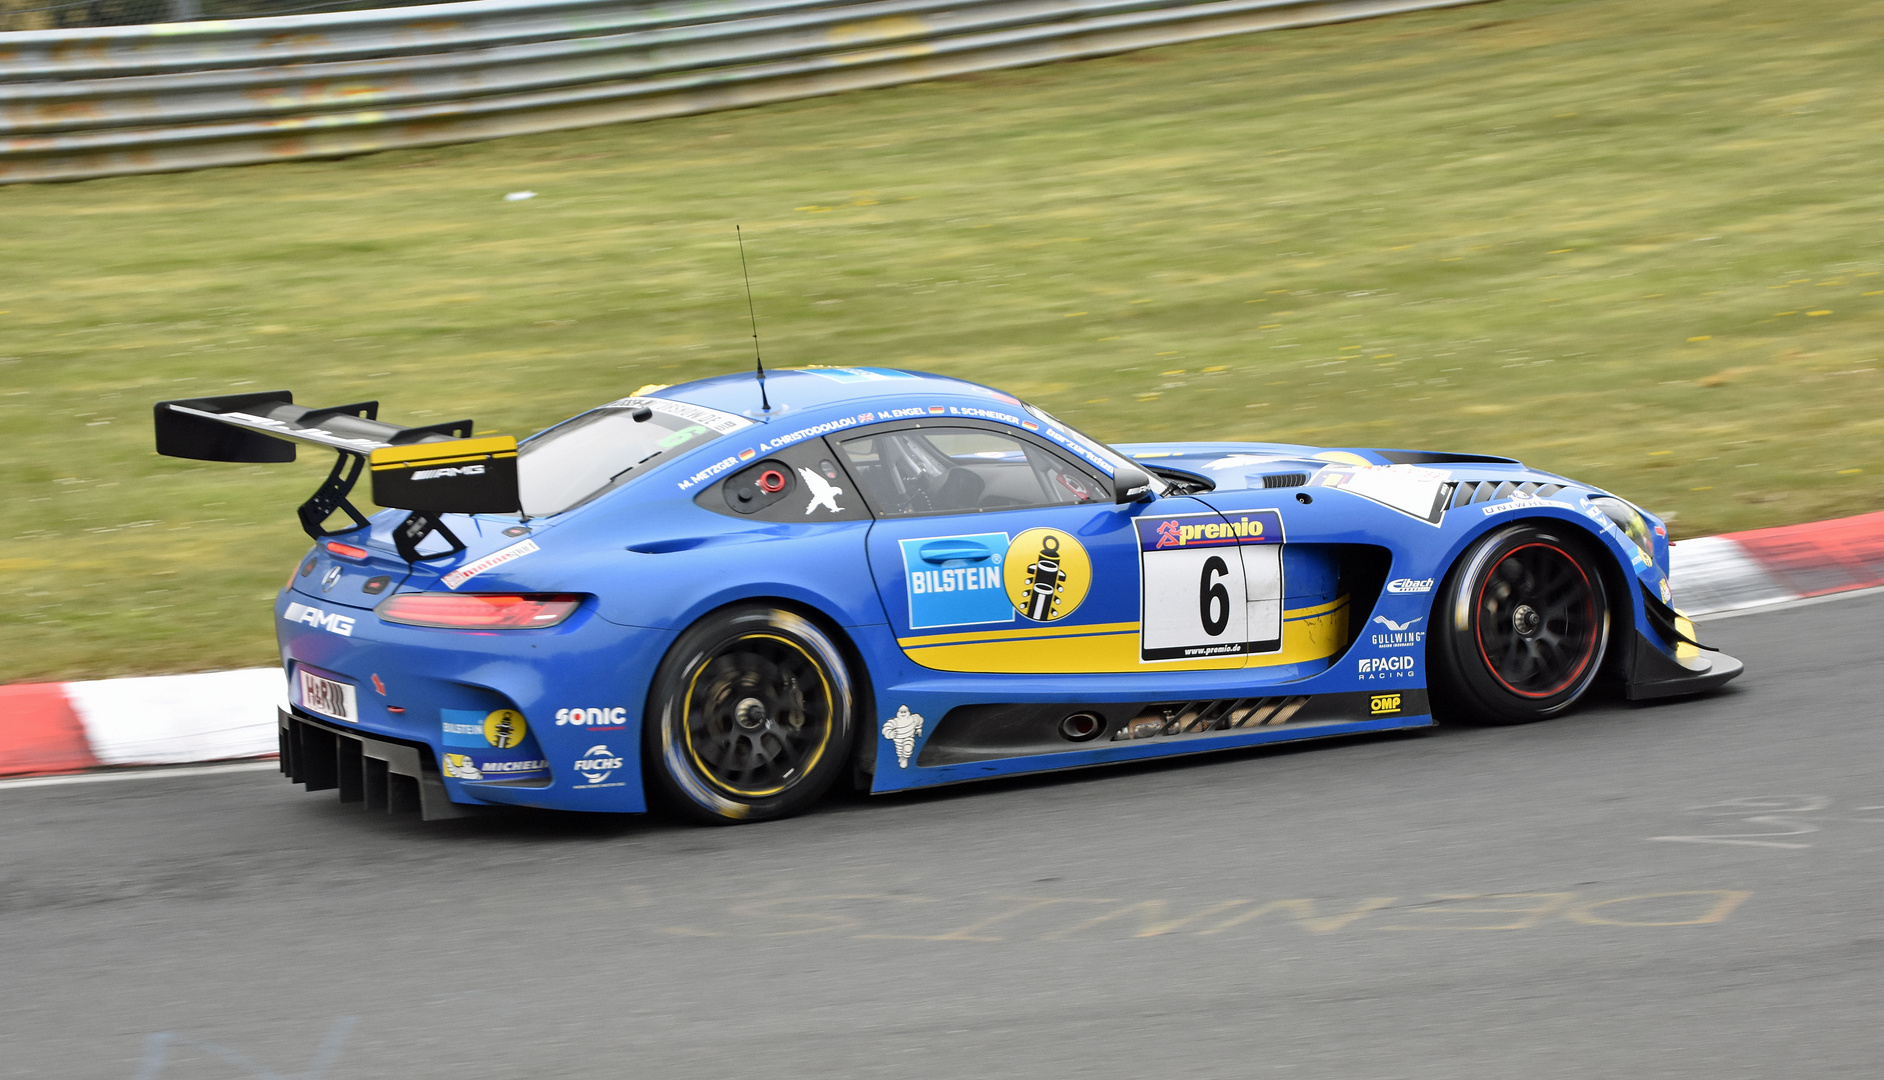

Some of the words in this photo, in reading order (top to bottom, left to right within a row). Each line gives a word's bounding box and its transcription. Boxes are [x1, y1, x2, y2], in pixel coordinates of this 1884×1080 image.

[877, 411, 893, 420] M.
[893, 406, 926, 418] ENGEL
[949, 406, 960, 414] B.
[961, 407, 1020, 425] SCHNEIDER
[760, 443, 773, 452] A.
[770, 416, 857, 447] CHRISTODOULOU
[436, 464, 486, 478] AMG
[677, 479, 694, 490] M.
[690, 456, 739, 483] METZGER
[1178, 516, 1264, 546] premio
[911, 566, 1001, 594] BILSTEIN
[1386, 577, 1435, 593] Eibach
[1199, 555, 1230, 637] 6
[299, 605, 356, 637] AMG
[1371, 631, 1422, 645] GULLWING
[1184, 644, 1242, 656] www.premio.de
[1371, 655, 1415, 672] PAGID
[1358, 670, 1415, 681] RACING
[1370, 696, 1401, 711] OMP
[442, 722, 483, 735] BILSTEIN
[573, 757, 624, 771] FUCHS
